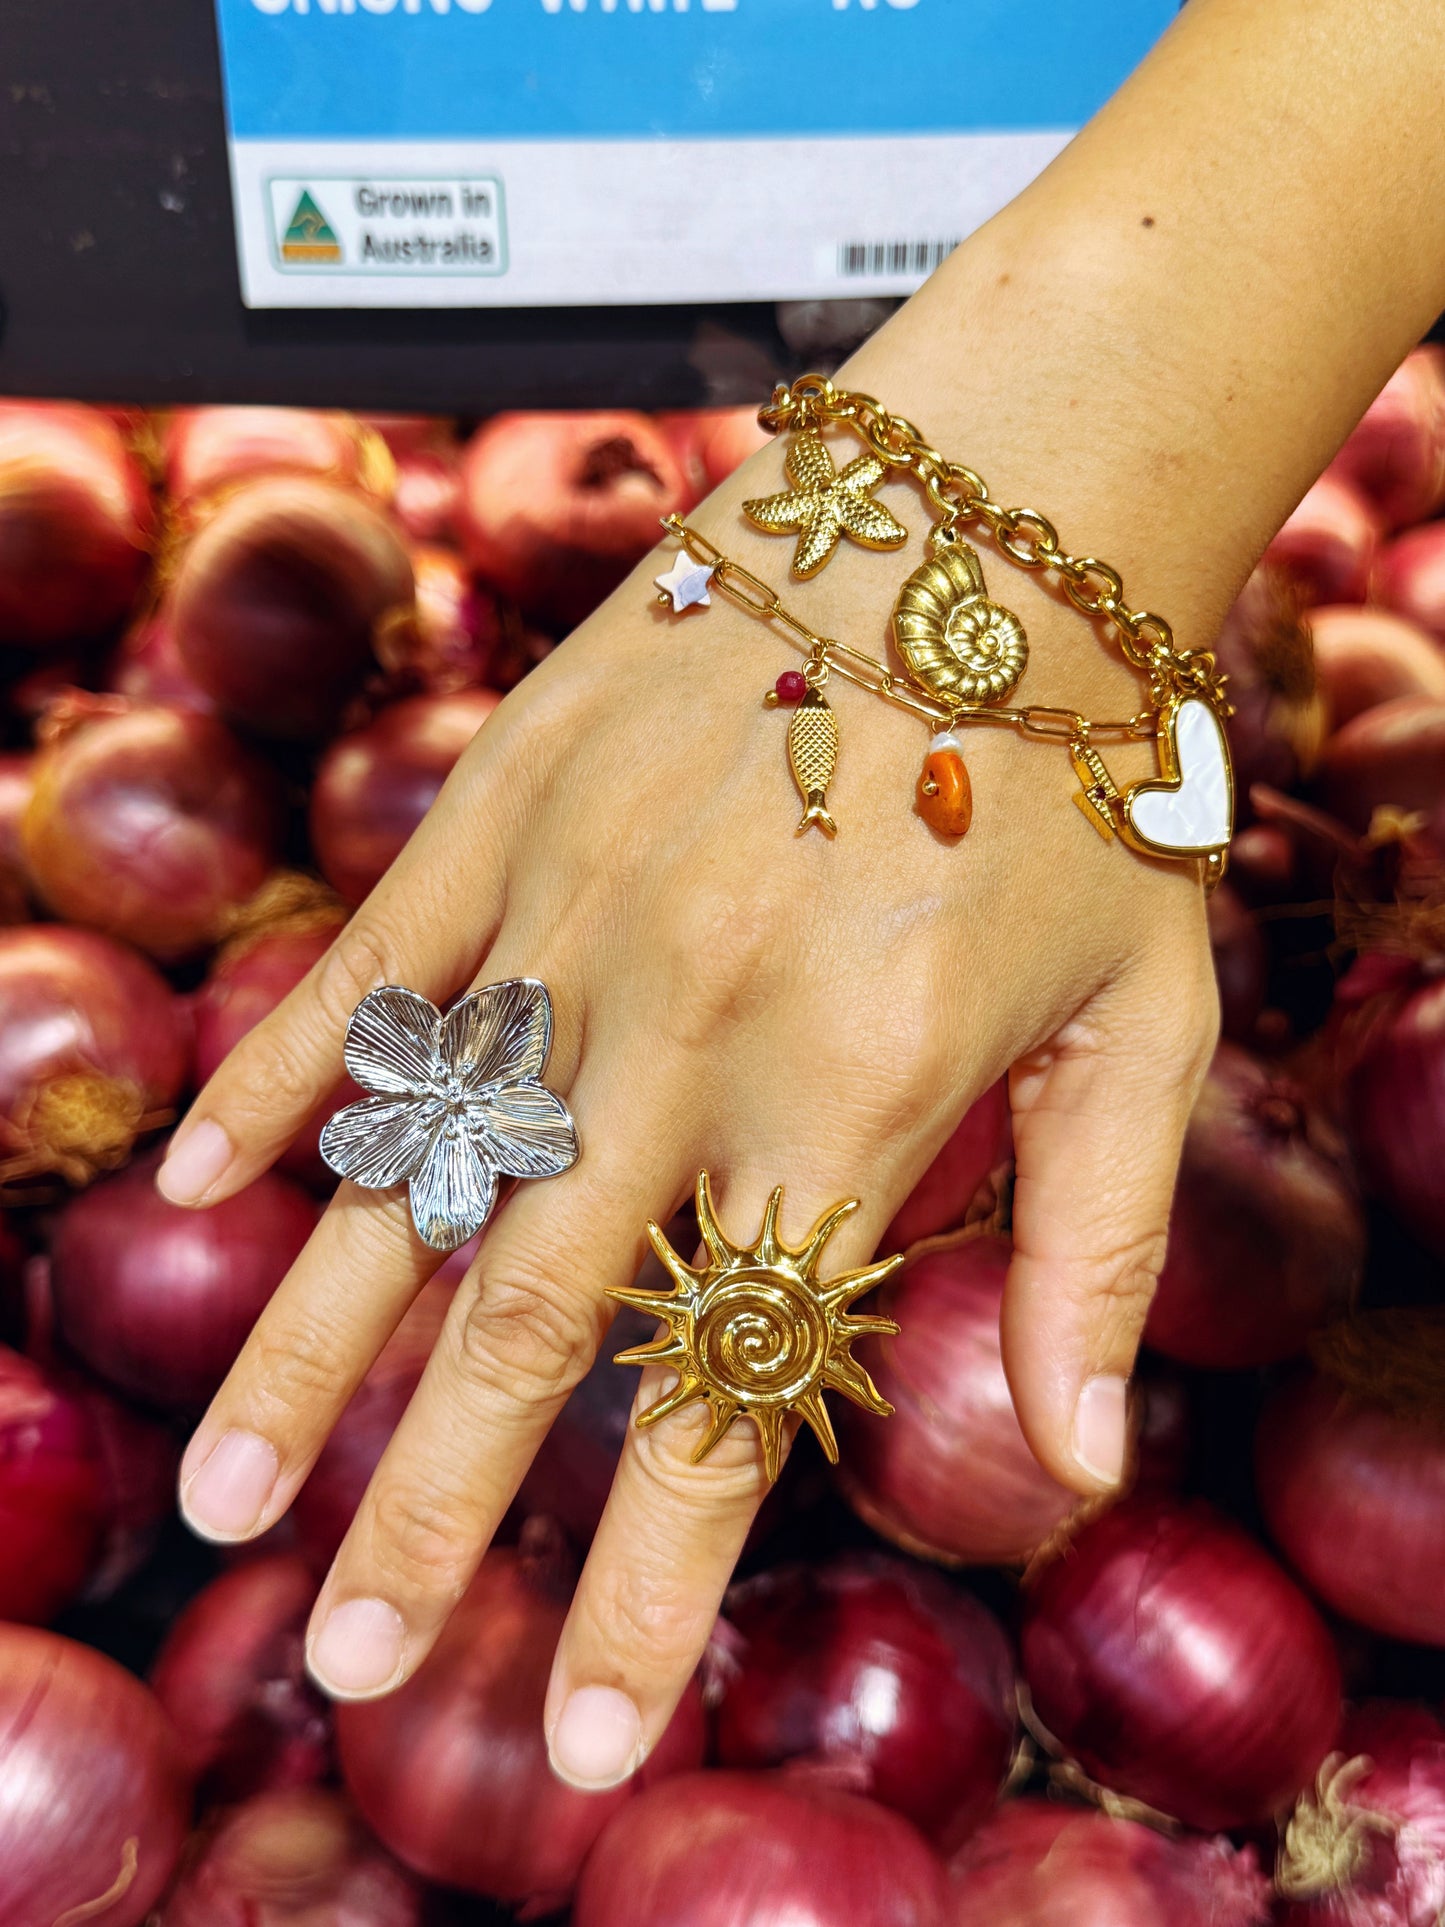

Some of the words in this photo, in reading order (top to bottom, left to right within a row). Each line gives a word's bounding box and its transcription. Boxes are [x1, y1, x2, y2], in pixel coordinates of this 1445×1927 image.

[356, 186, 453, 218] Grown
[461, 185, 491, 218] in
[361, 232, 494, 264] Australia
